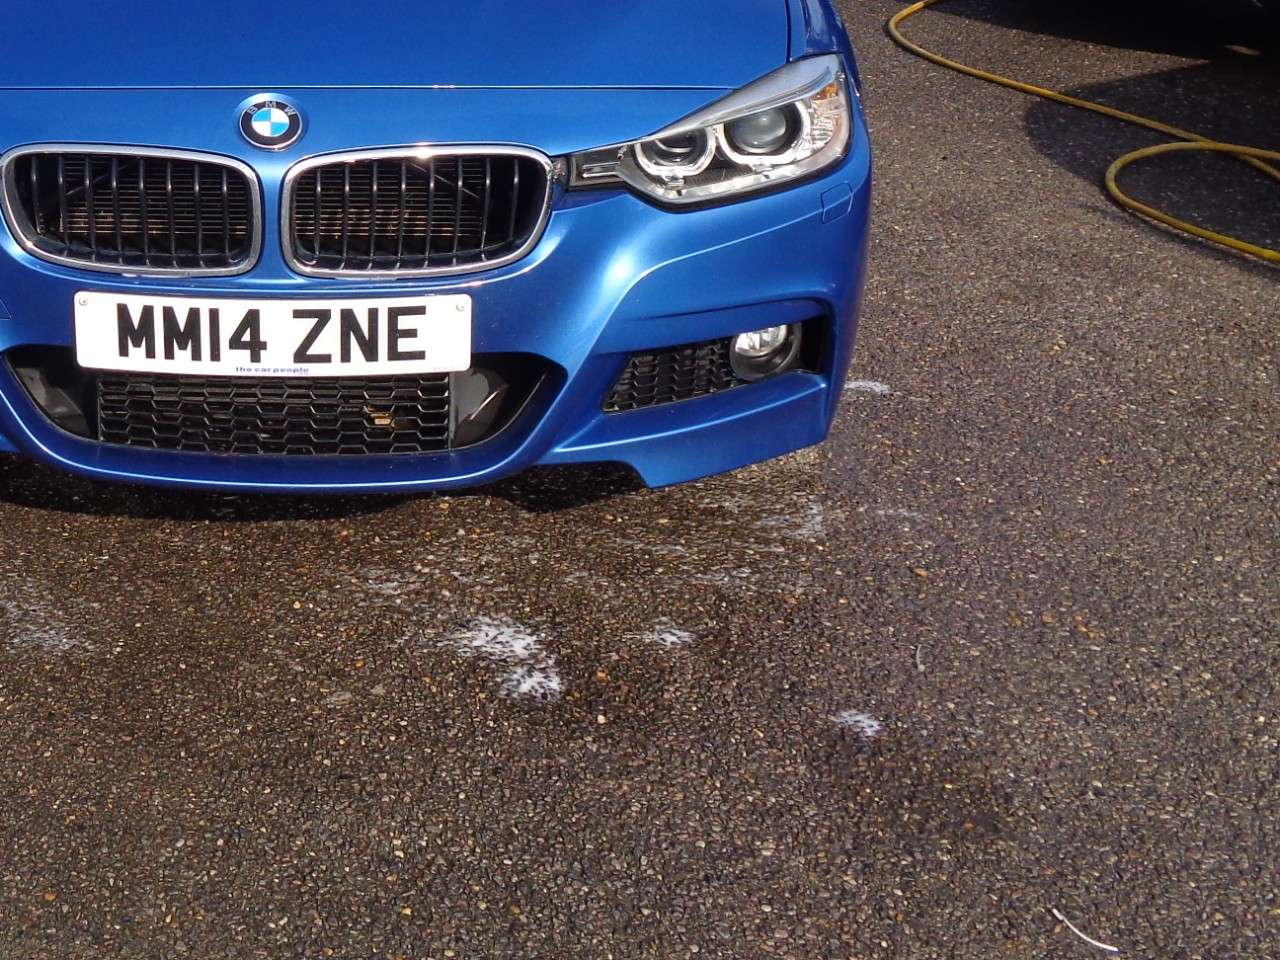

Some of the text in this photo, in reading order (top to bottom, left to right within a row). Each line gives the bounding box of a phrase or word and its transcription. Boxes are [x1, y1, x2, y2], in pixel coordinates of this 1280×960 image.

[247, 101, 297, 116] BMW
[116, 302, 427, 364] MM14 ZNE
